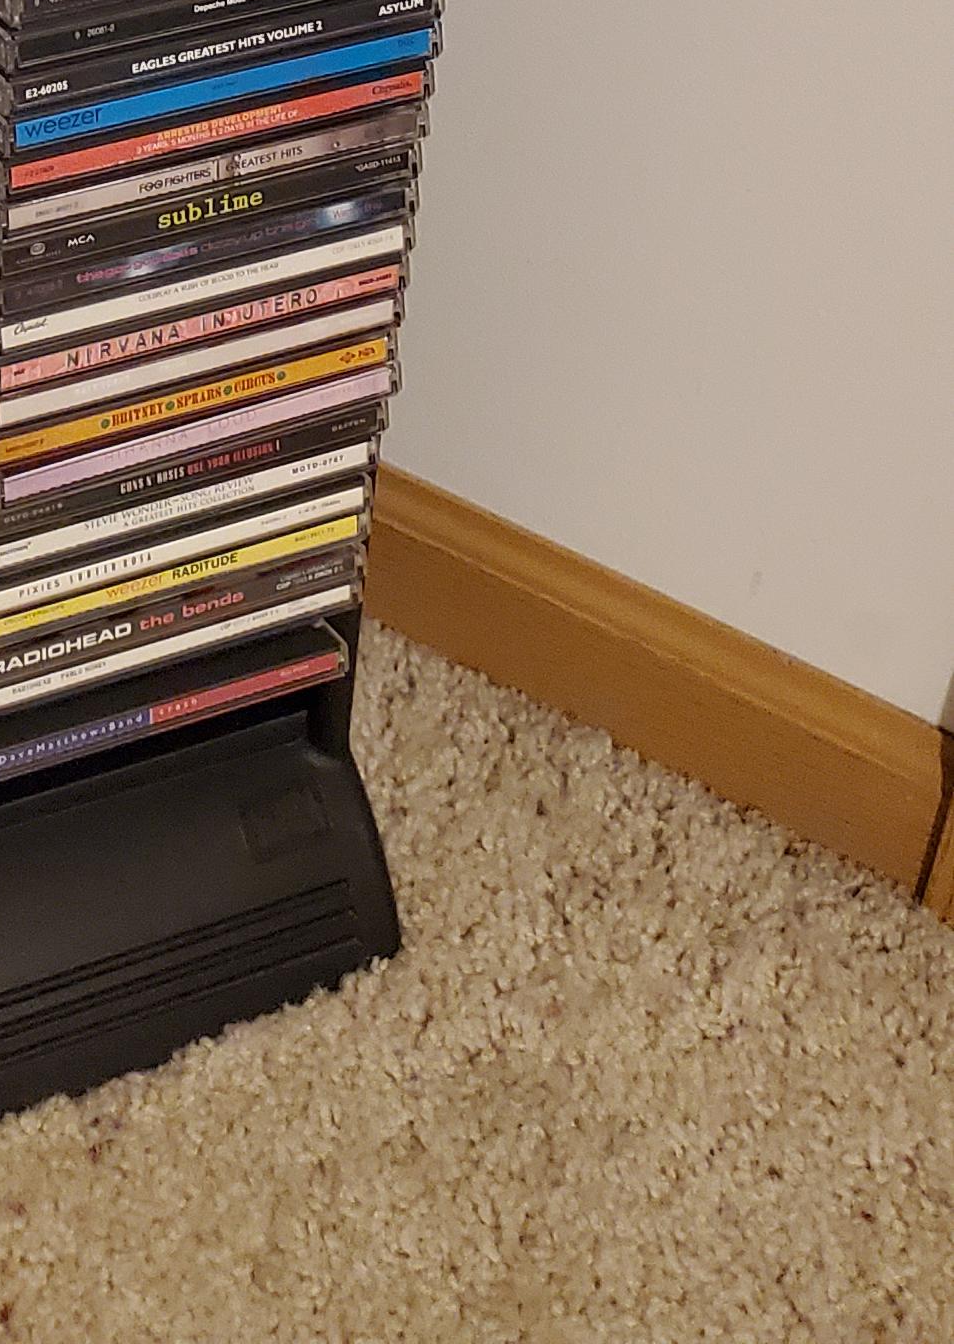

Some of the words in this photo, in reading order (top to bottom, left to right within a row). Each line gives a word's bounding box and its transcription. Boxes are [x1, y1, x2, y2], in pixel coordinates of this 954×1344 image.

[131, 53, 177, 75] EAGLES
[178, 40, 235, 63] GREATEST
[238, 33, 265, 49] HITS
[268, 23, 314, 42] VOLUME
[316, 20, 323, 31] 2
[24, 108, 102, 139] weezer
[157, 191, 263, 230] sublime
[67, 232, 95, 248] MCA
[66, 324, 180, 367] NIRVANA
[202, 311, 226, 332] IN
[242, 287, 318, 322] UTERO
[172, 552, 239, 580] RADITUDE
[139, 611, 174, 630] the
[181, 590, 245, 618] bends
